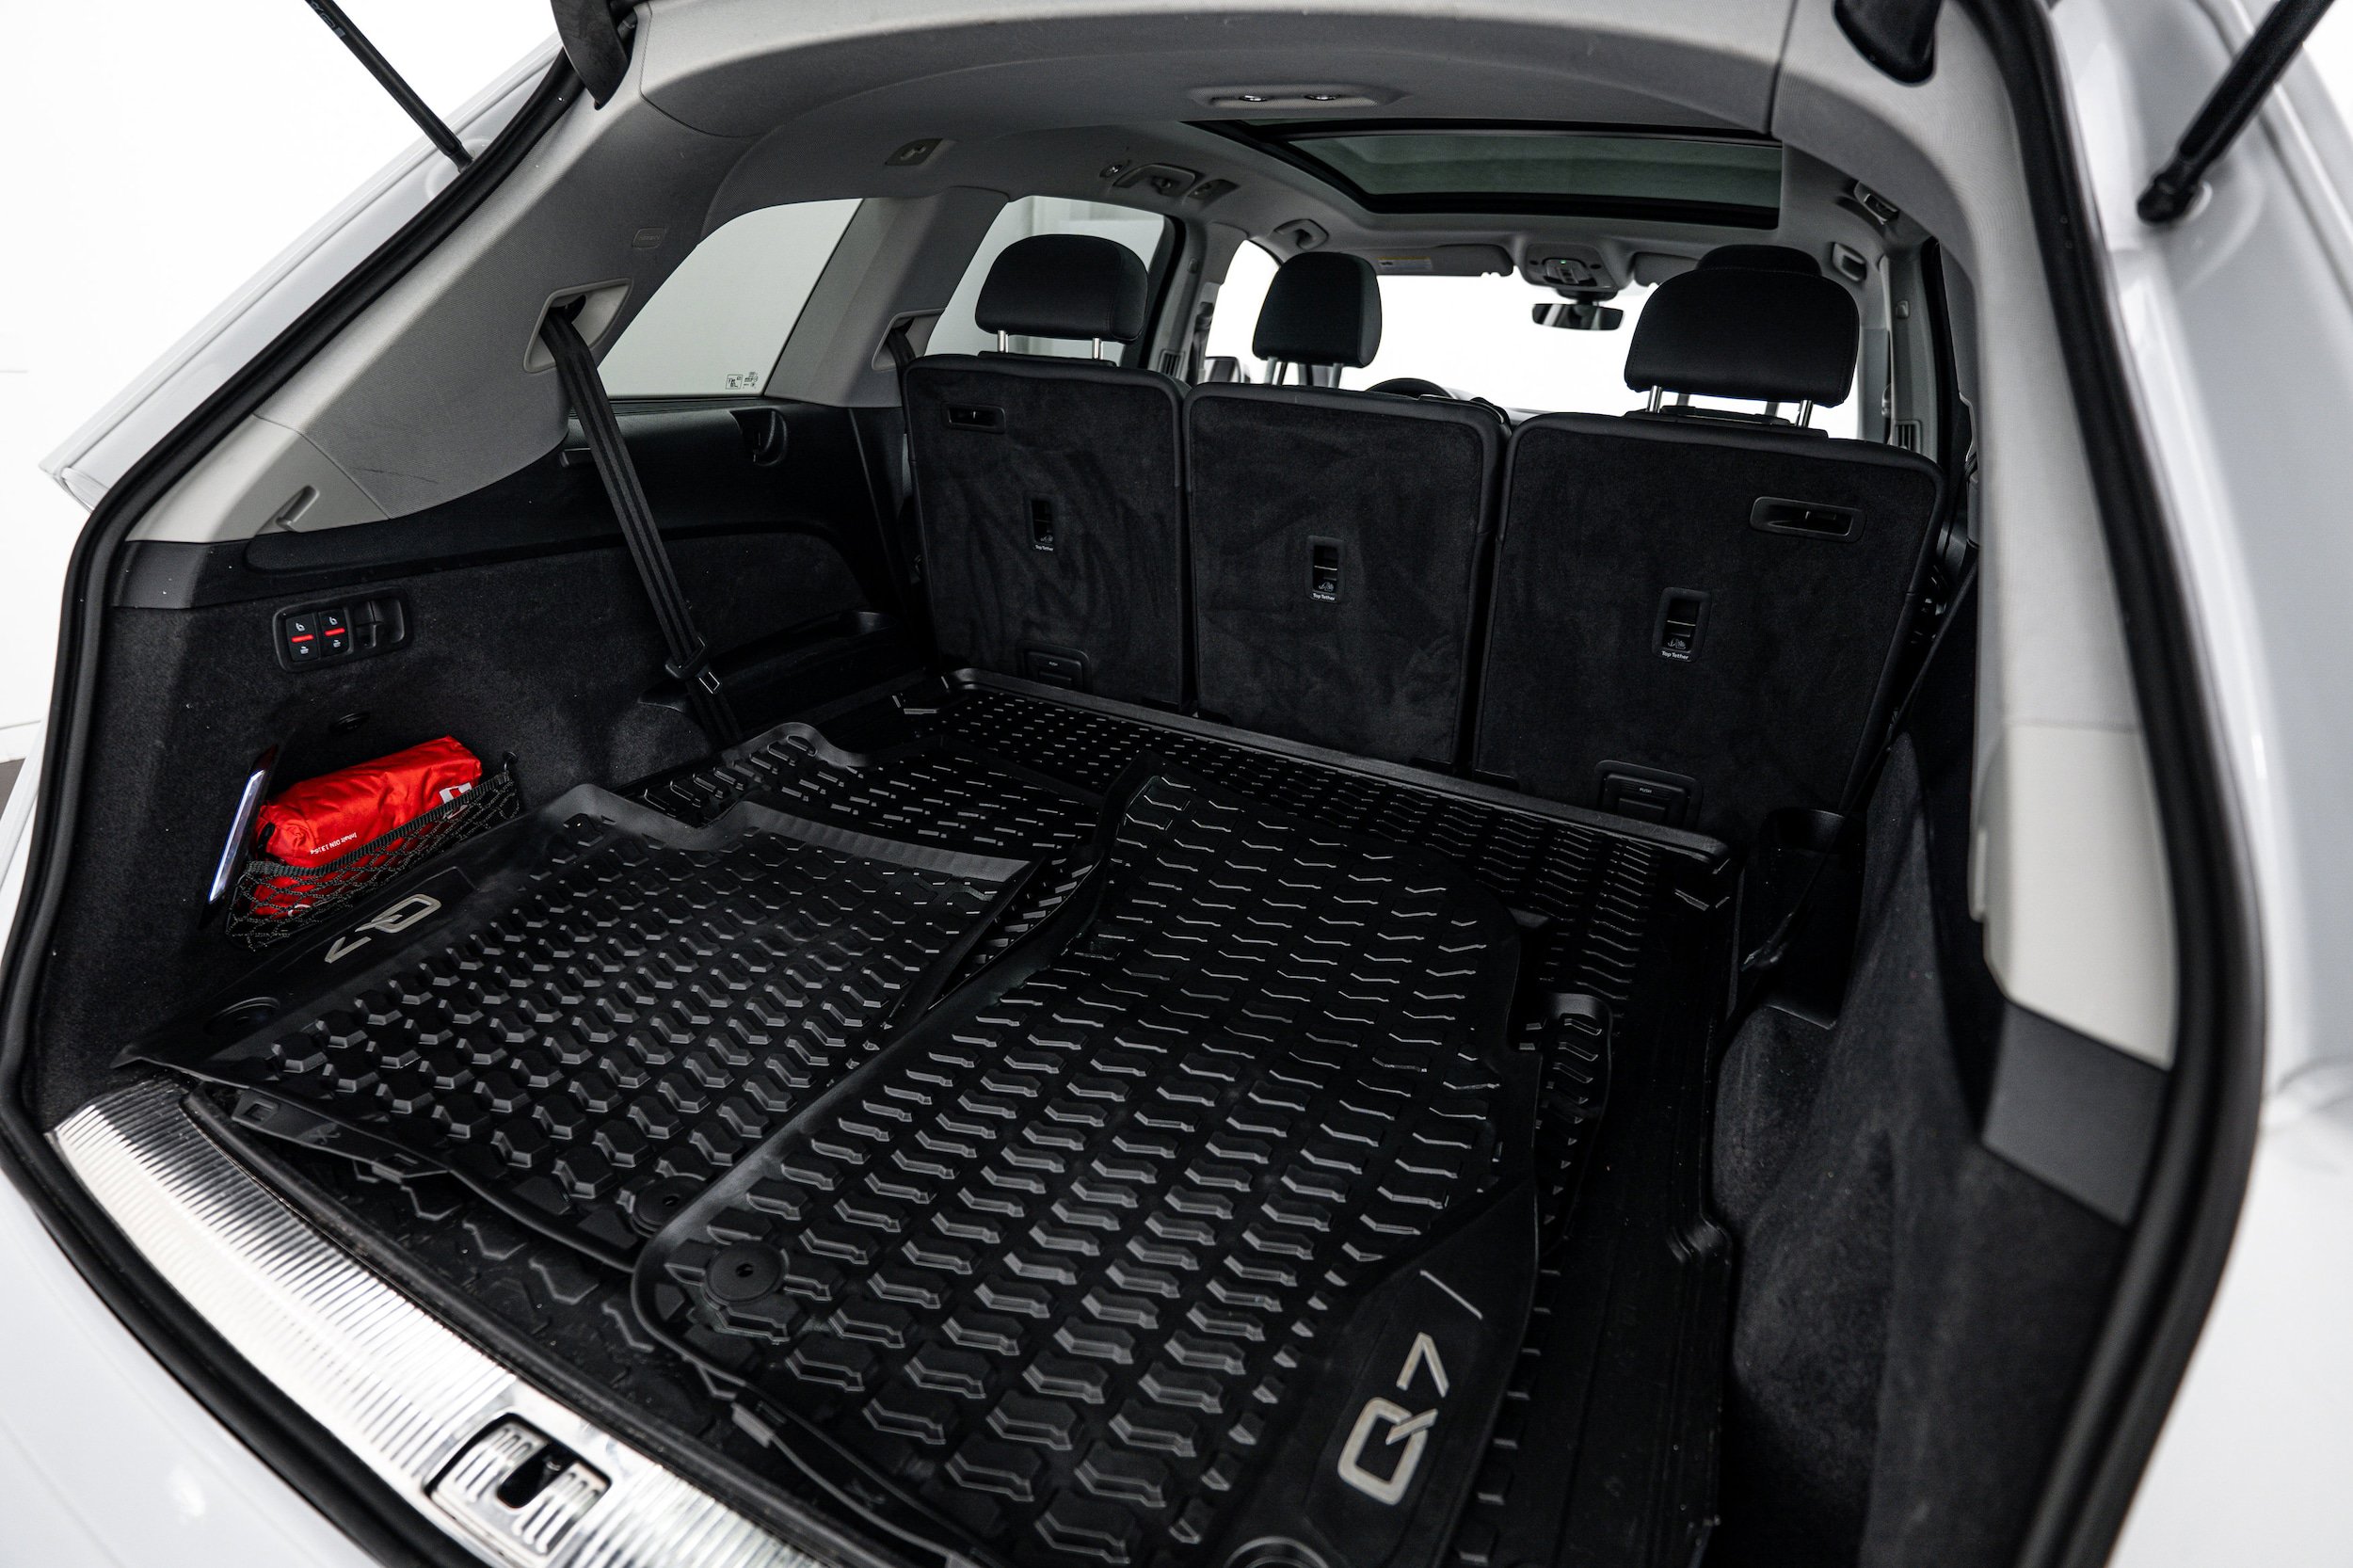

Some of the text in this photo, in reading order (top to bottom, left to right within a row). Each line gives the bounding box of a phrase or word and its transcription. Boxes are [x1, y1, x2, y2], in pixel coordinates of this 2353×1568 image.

[1672, 651, 1689, 660] Tether
[341, 832, 357, 843] Inhalt
[329, 840, 341, 849] DIN
[325, 894, 441, 964] Q7
[1337, 1332, 1449, 1506] Q7
